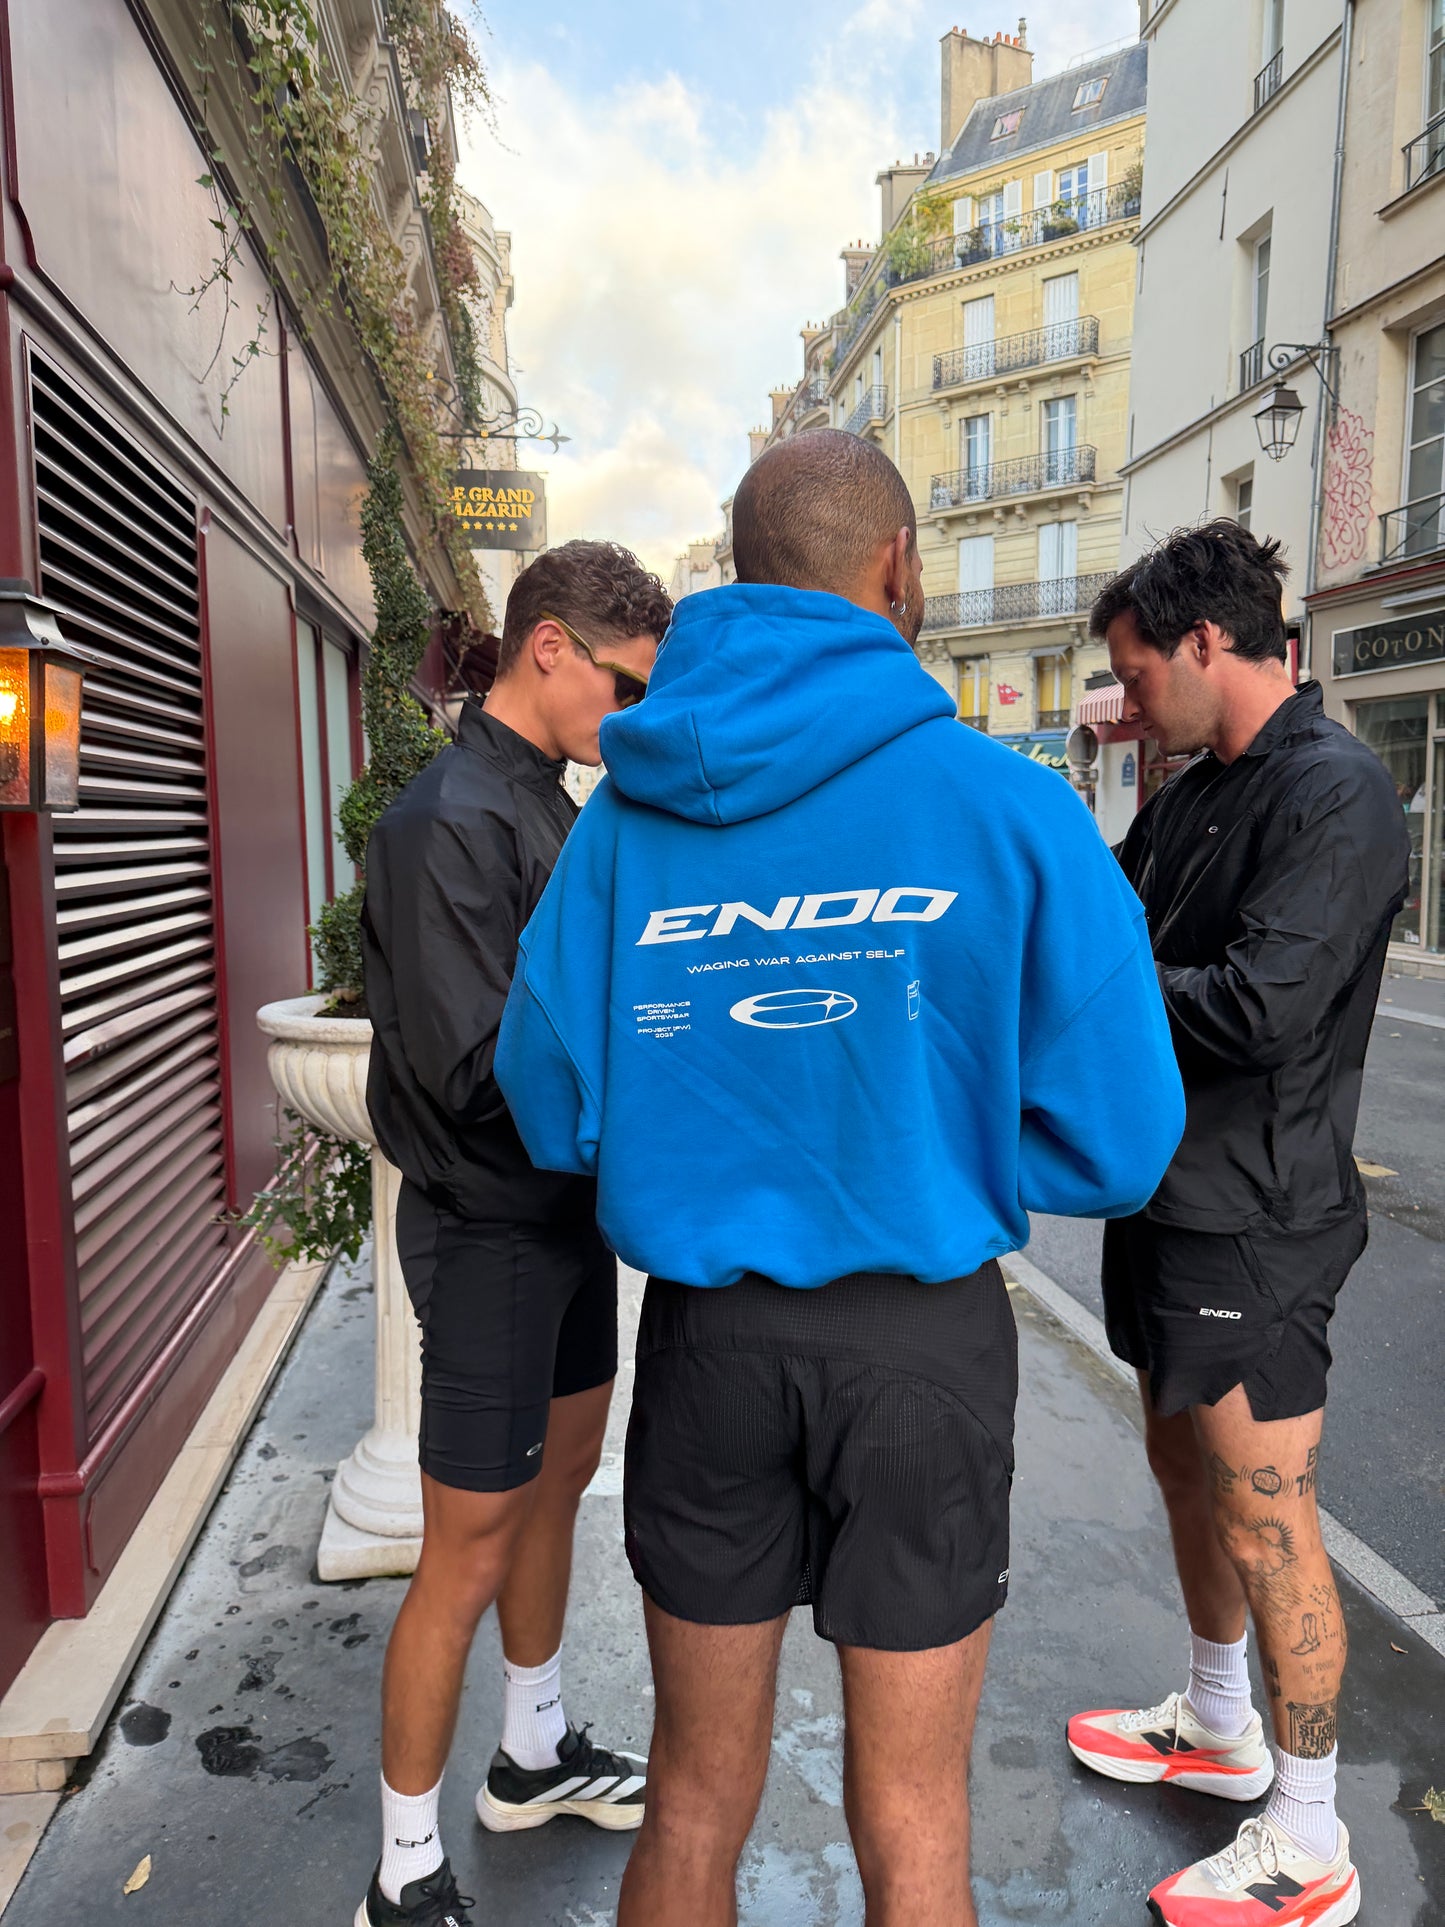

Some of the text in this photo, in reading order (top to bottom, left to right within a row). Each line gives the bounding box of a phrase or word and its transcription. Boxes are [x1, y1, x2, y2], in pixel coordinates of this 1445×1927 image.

[469, 487, 535, 504] GRAND
[635, 887, 959, 946] ENDO
[687, 949, 905, 974] WAGING WAR AGAINST SELF
[633, 1001, 691, 1011] PERFORMANCE
[637, 1013, 690, 1022] SPORTSWEAR
[1199, 1307, 1242, 1320] ENDO
